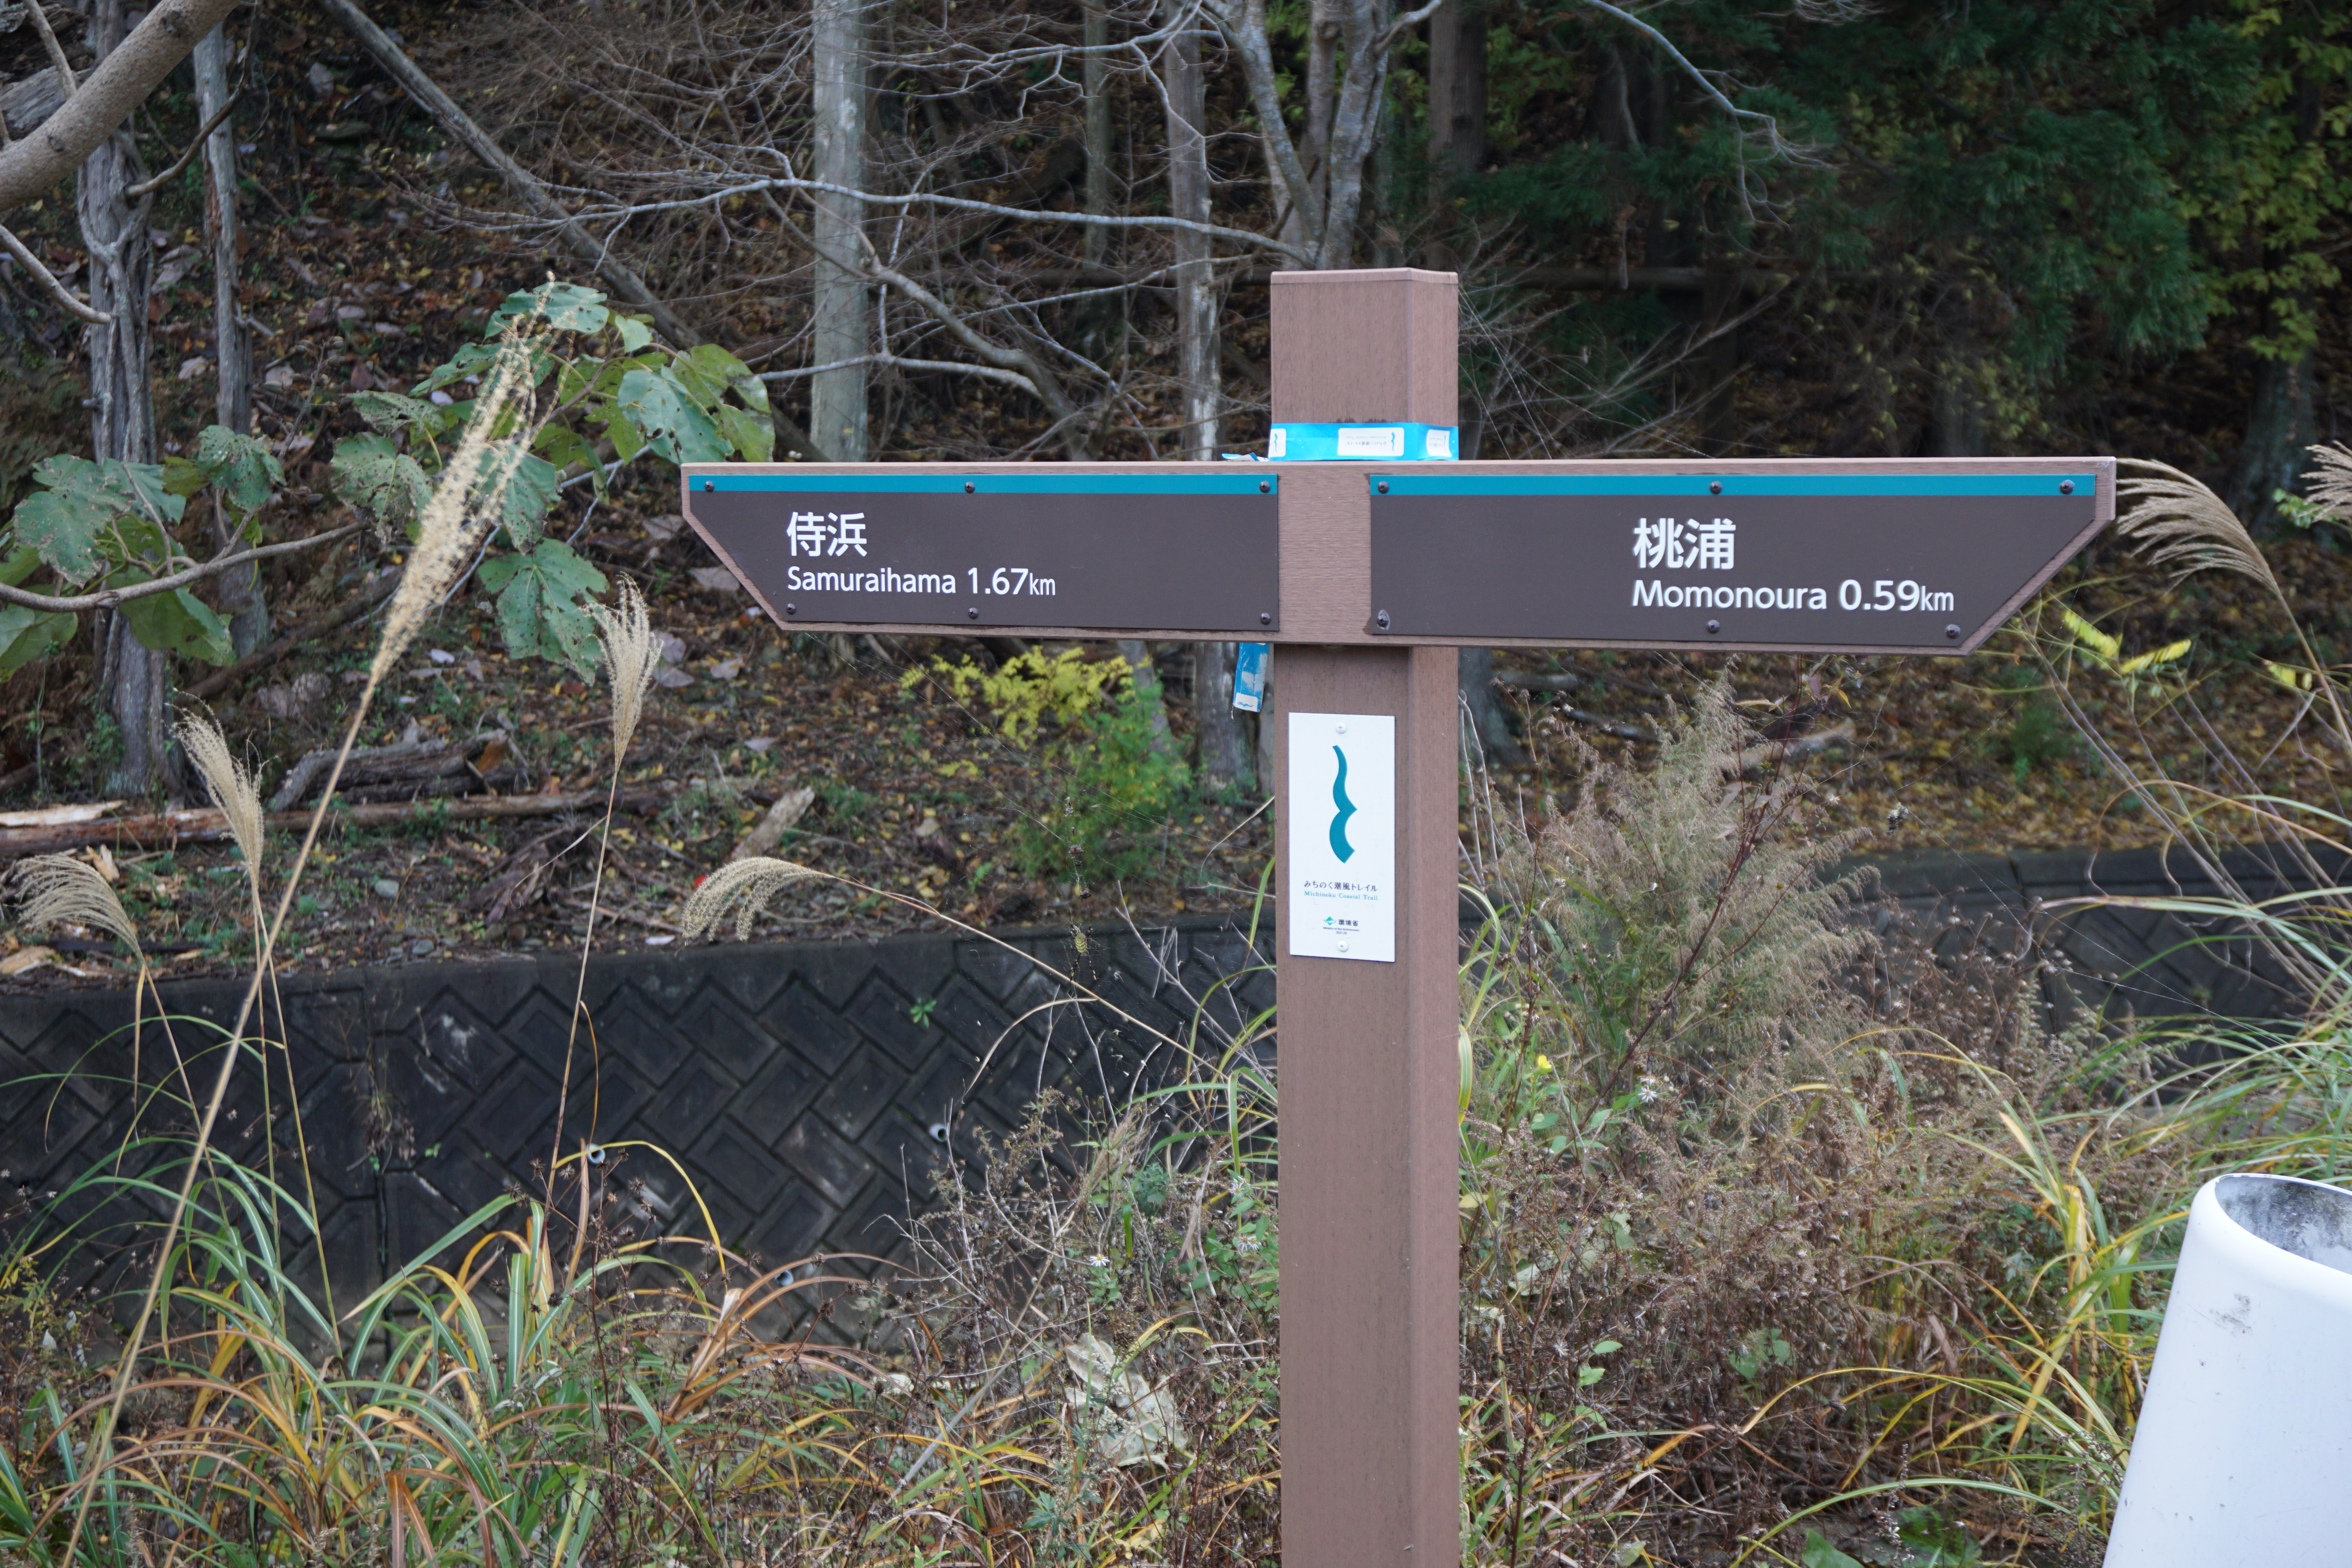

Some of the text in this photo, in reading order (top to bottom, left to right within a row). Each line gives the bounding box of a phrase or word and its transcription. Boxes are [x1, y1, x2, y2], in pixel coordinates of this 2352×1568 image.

[786, 512, 867, 557] 侍浜
[1633, 518, 1736, 570] 桃浦
[788, 566, 1056, 595] Samuraihama 1.67km
[1633, 579, 1954, 611] Momonoura 0.59km
[1304, 880, 1378, 892] みちのく潮風トレイル
